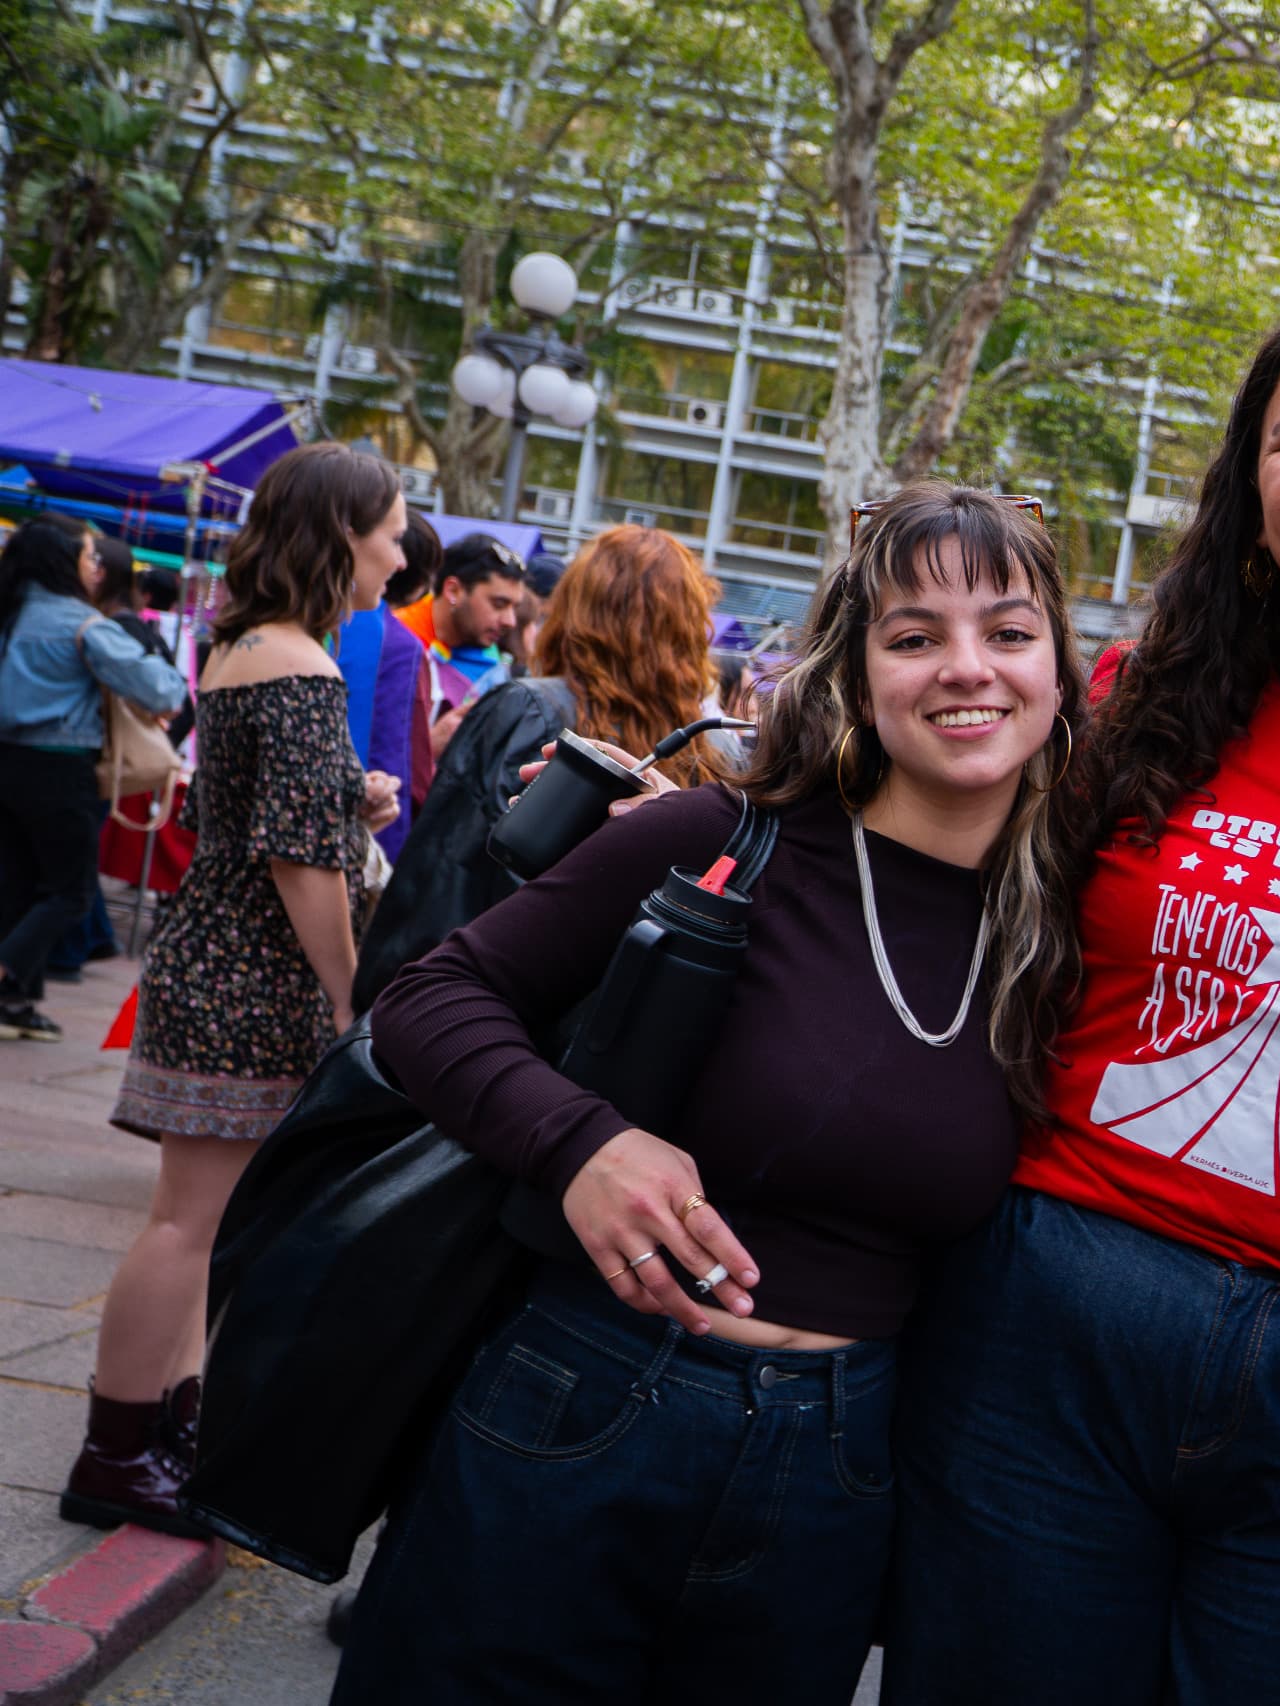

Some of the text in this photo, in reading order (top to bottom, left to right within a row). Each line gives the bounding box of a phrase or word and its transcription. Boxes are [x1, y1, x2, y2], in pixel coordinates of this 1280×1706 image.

[1209, 832, 1262, 858] ES
[1151, 883, 1262, 976] TENEMOS
[1134, 962, 1166, 1056] A
[1153, 965, 1225, 1054] SER
[1229, 984, 1255, 1026] Y
